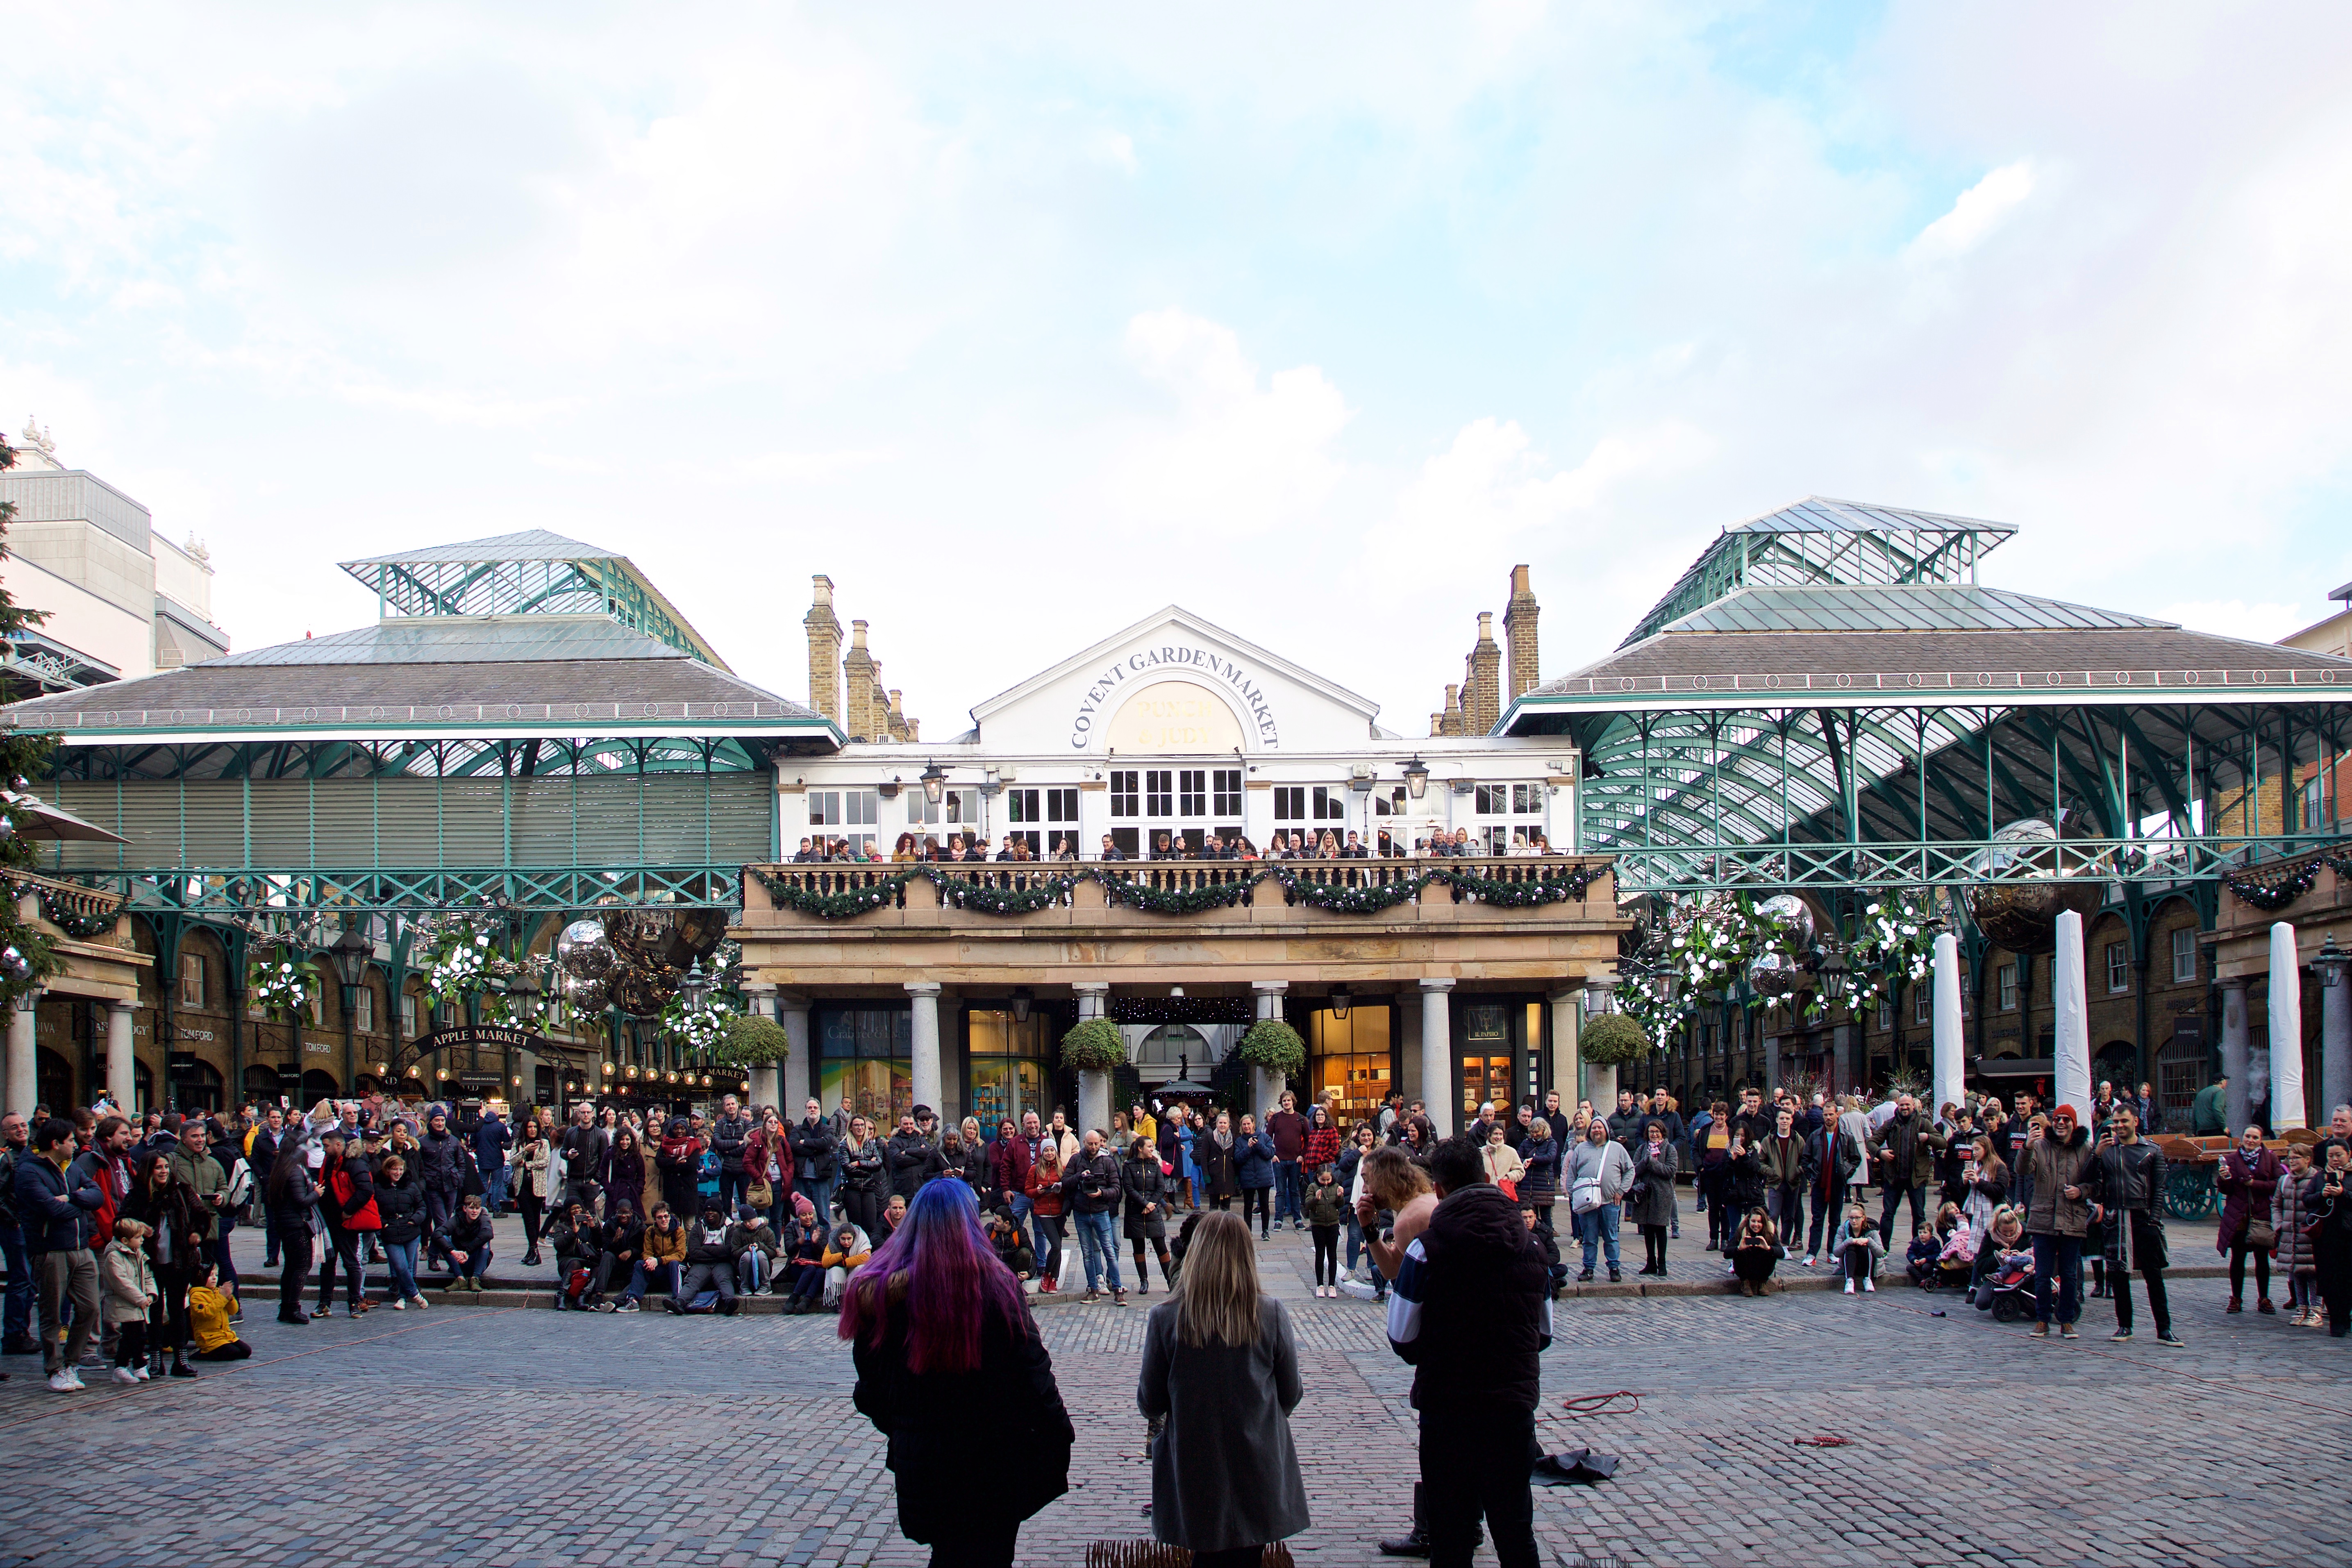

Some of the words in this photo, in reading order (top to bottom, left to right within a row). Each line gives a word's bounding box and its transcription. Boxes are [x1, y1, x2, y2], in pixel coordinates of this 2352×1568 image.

[1072, 664, 1126, 749] COVENT
[1129, 647, 1223, 672] GARDEN
[1222, 662, 1278, 749] MARKET
[1136, 701, 1213, 718] PUNCH
[1138, 727, 1152, 744] &
[1157, 727, 1213, 748] JUDY
[1118, 999, 1183, 1009] CENTRAL
[1186, 998, 1242, 1009] AVENUE
[35, 1021, 55, 1034] DIVA
[180, 1028, 195, 1039] TOM
[195, 1030, 214, 1041] FORD
[434, 1030, 470, 1047] APPLE
[475, 1029, 530, 1046] MARKET
[305, 1042, 317, 1052] TOM
[317, 1044, 331, 1053] FORD
[708, 1068, 745, 1080] MARKET
